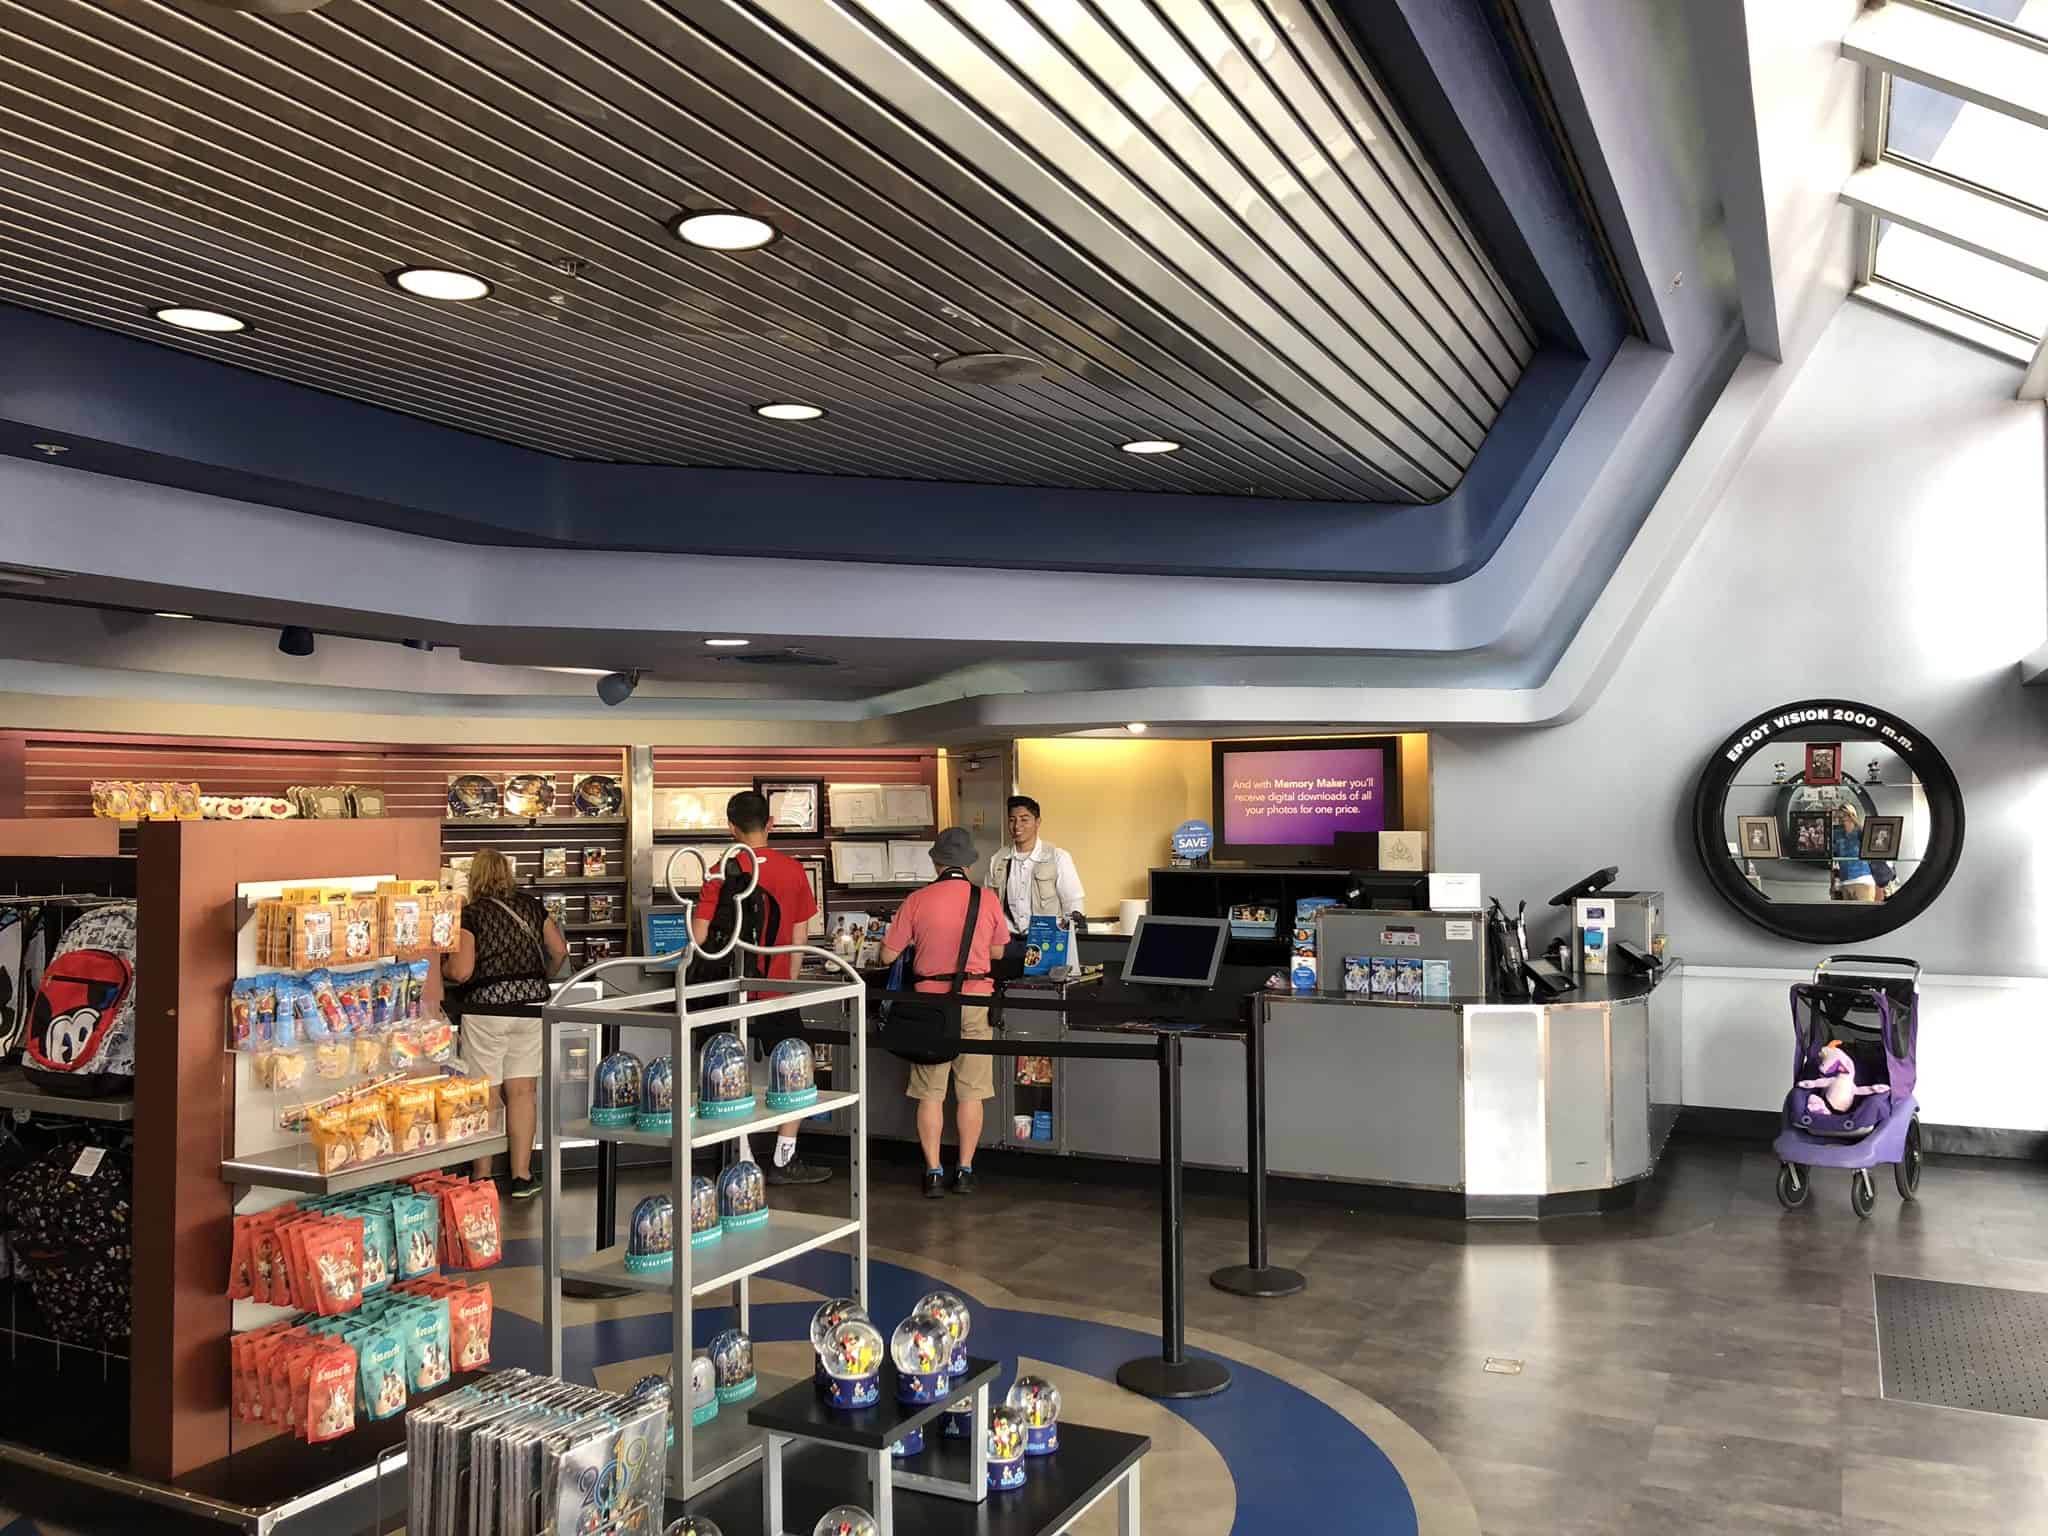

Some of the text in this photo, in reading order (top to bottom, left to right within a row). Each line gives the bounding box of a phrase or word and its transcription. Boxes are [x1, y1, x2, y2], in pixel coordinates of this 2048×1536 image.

[1726, 724, 1770, 762] EPCOT
[1773, 708, 1829, 730] VISION
[1833, 708, 1878, 728] 2000
[1232, 776, 1374, 791] And with Memory Maker you'll
[1234, 790, 1372, 804] receive digital downloads of all
[1245, 804, 1360, 817] your photos for one price.
[1178, 837, 1209, 849] SAVE
